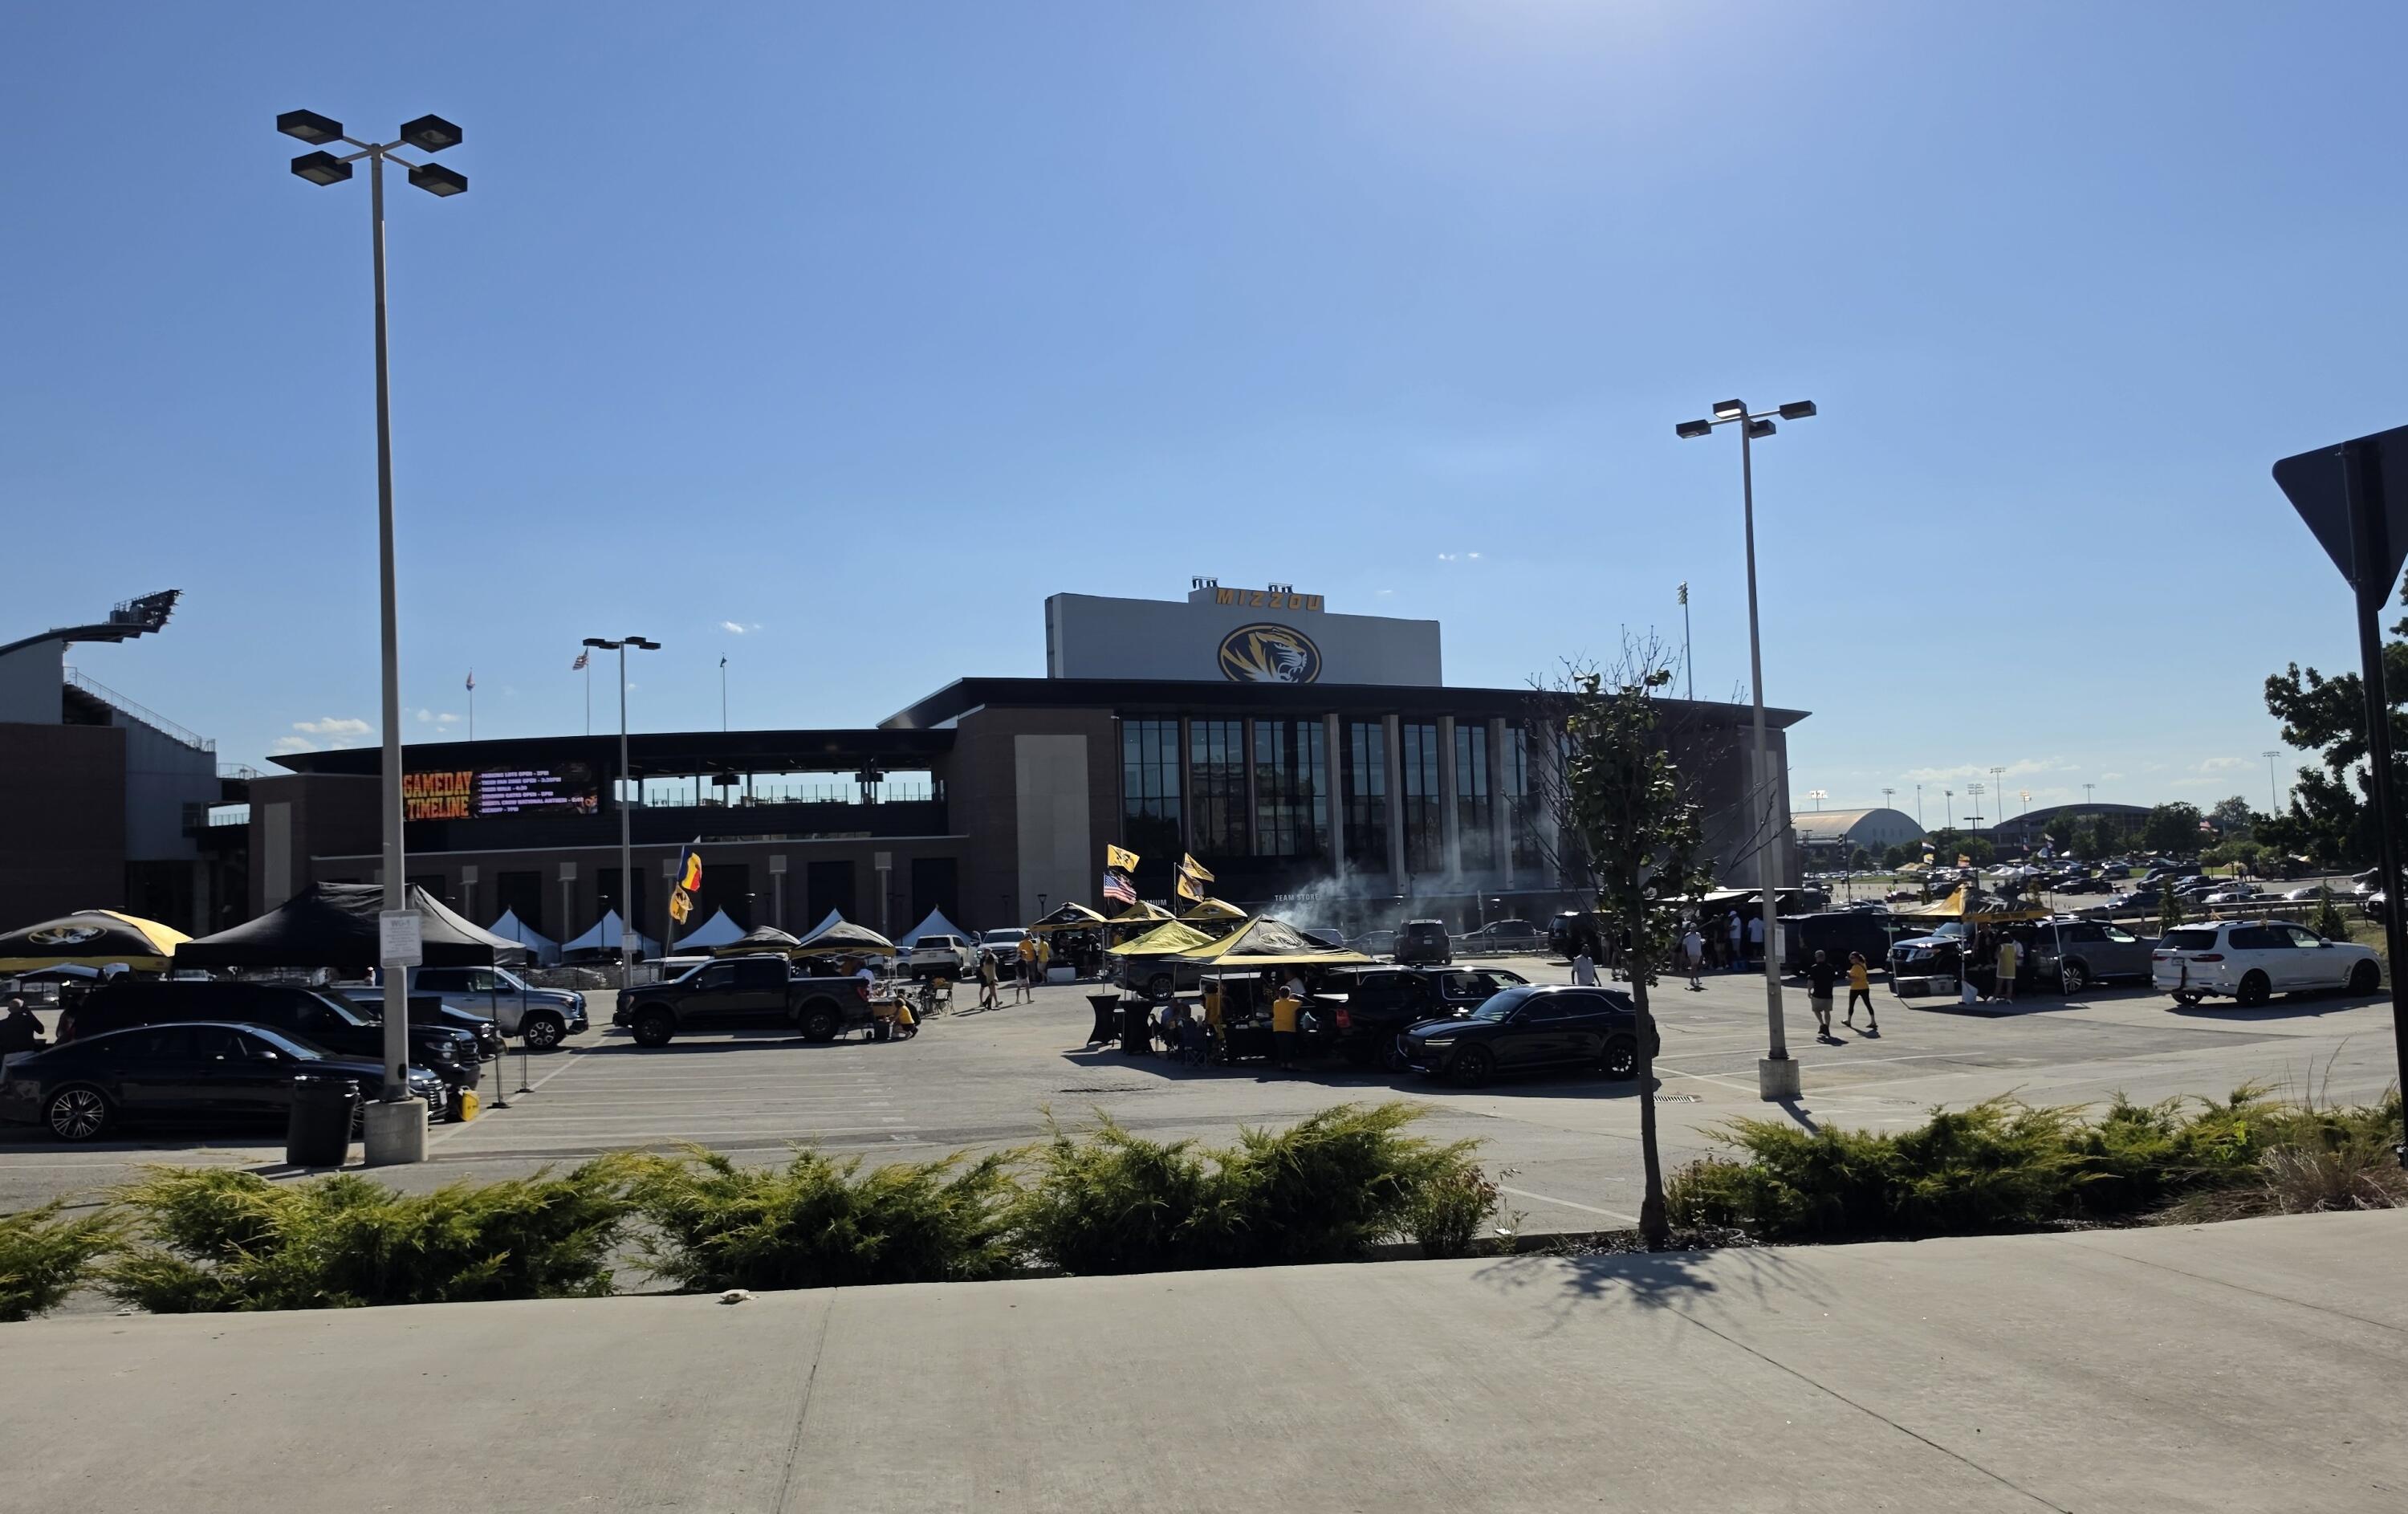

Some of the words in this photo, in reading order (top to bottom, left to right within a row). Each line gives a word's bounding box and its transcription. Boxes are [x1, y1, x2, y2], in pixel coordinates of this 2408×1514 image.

[1216, 588, 1320, 611] MIZZOU
[404, 771, 473, 798] GAMEDAY
[408, 796, 469, 819] TIMELINE
